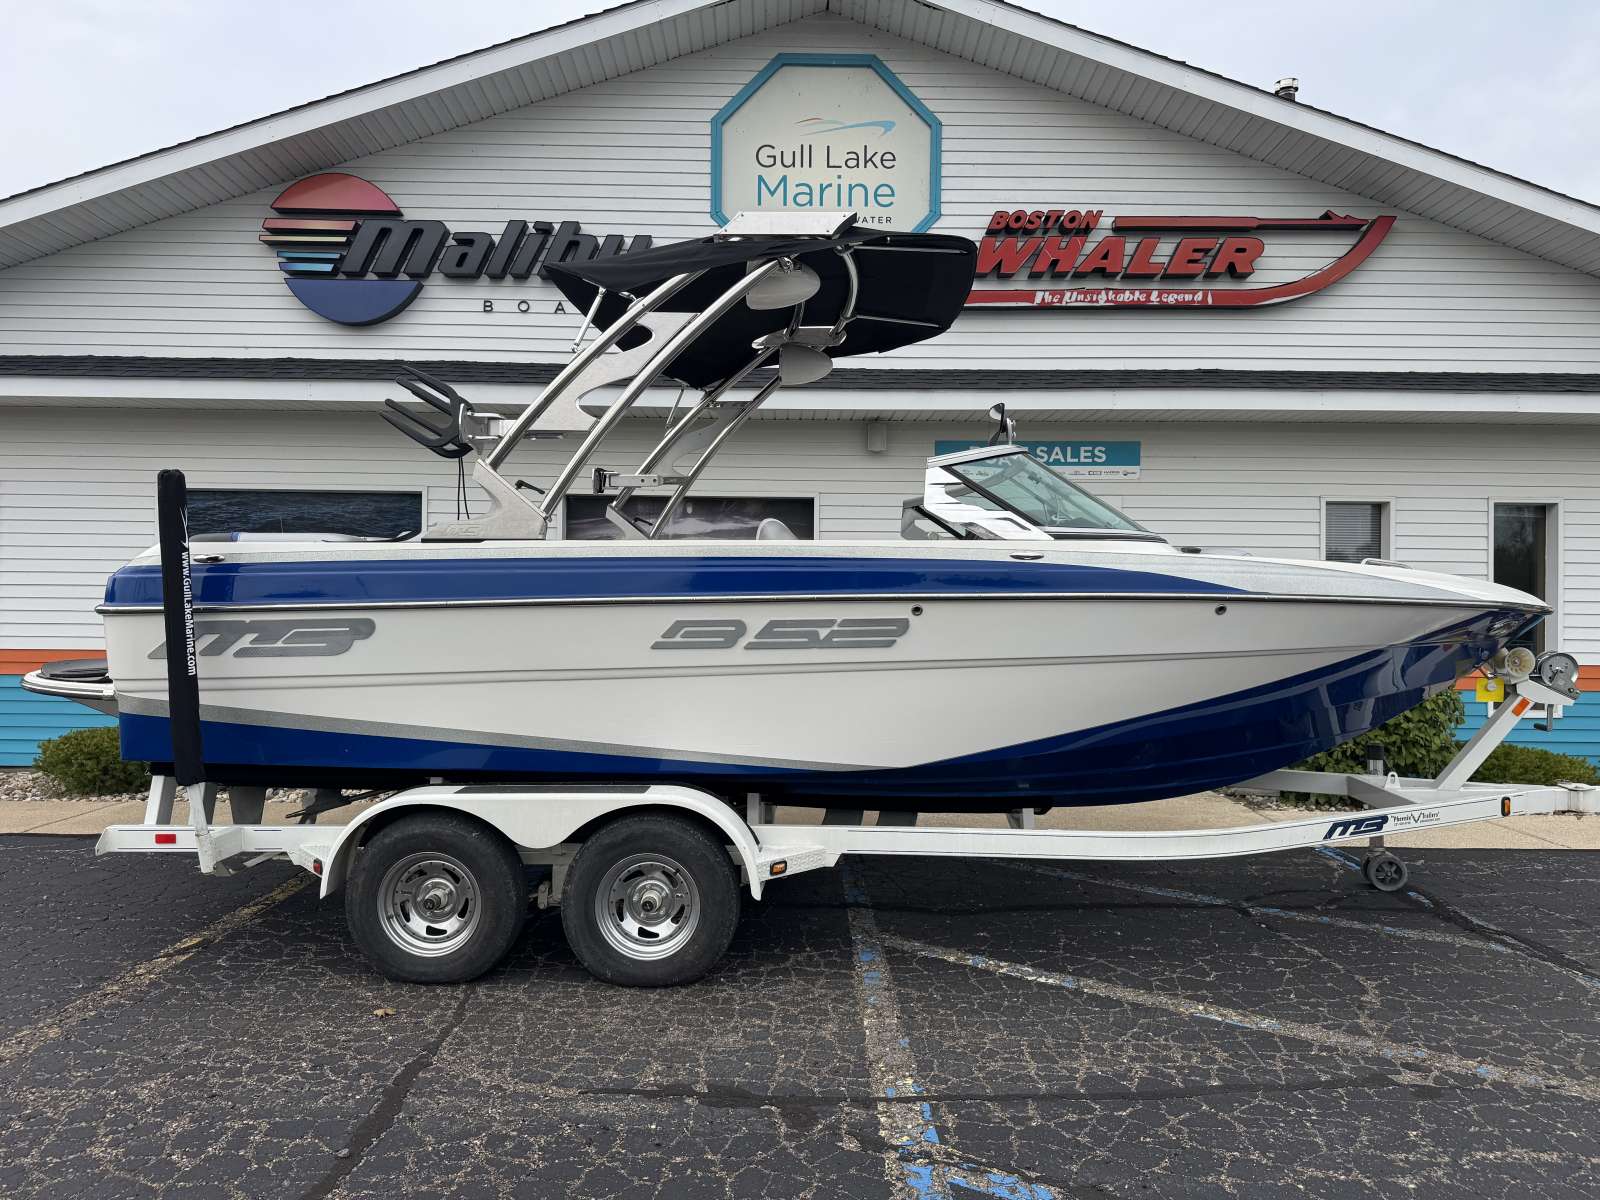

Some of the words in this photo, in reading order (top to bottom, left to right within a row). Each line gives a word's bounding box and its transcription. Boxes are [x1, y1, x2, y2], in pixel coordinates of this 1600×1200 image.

[755, 144, 812, 169] Gull
[826, 144, 897, 169] Lake
[757, 174, 896, 208] Marine
[986, 210, 1103, 235] BOSTON
[975, 236, 1264, 278] WHALER
[483, 300, 566, 314] BOA
[1034, 290, 1060, 304] The
[1150, 290, 1203, 304] Legend
[1036, 446, 1106, 463] SALES
[181, 551, 196, 675] www.GullLakeMarine.com
